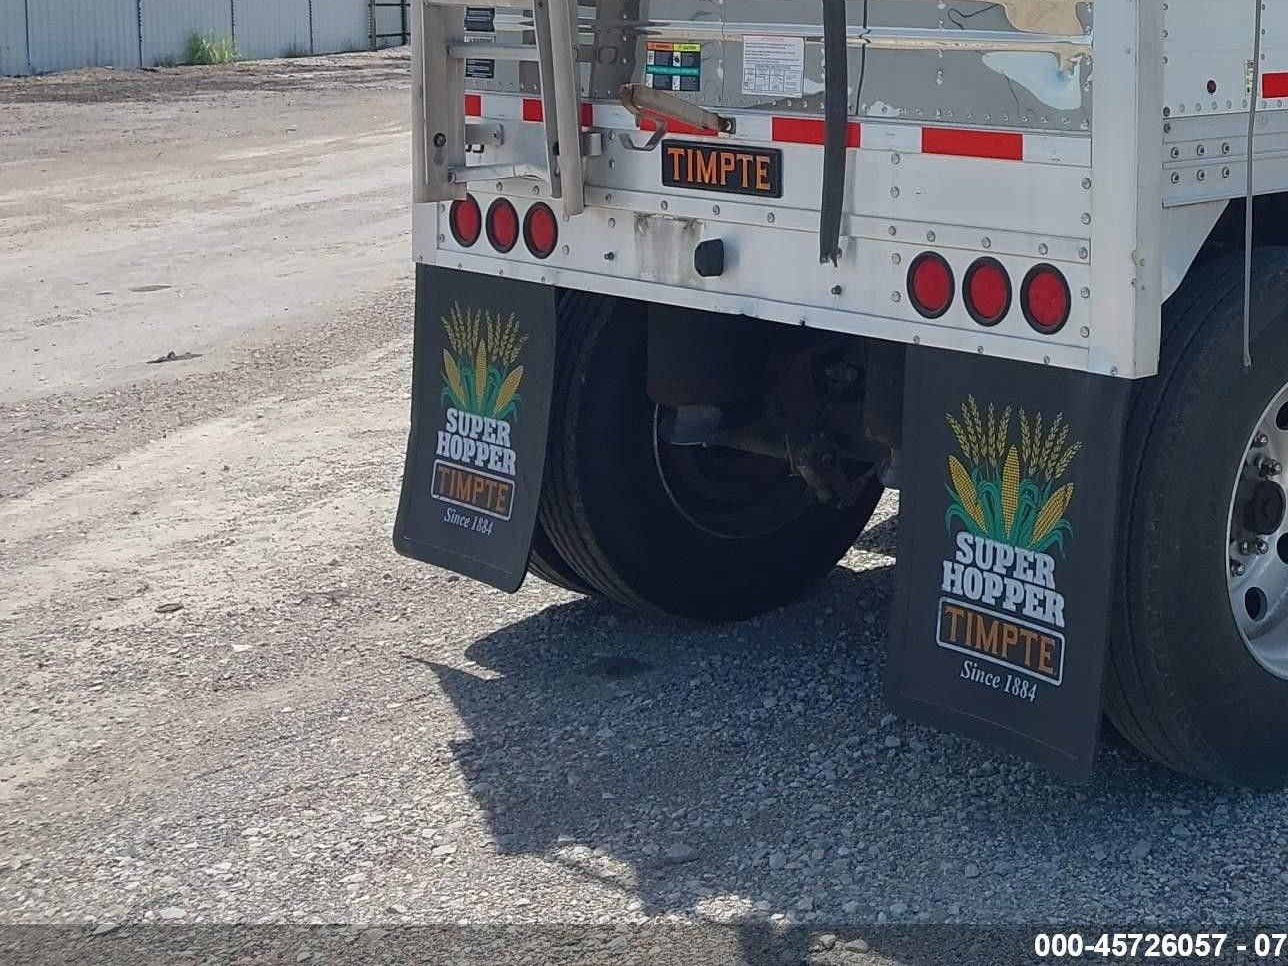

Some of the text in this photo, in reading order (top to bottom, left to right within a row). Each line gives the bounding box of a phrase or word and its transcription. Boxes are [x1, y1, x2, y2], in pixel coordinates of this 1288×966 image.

[667, 147, 771, 191] TIMPTE
[446, 407, 511, 448] SUPER
[436, 430, 516, 476] HOPPER
[437, 466, 509, 515] TIMPTE
[443, 507, 495, 536] Since 1884
[955, 530, 1056, 590] SUPER
[941, 560, 1066, 628] HOPPER
[943, 605, 1056, 676] TIMPTE
[960, 659, 1039, 703] Since 1884
